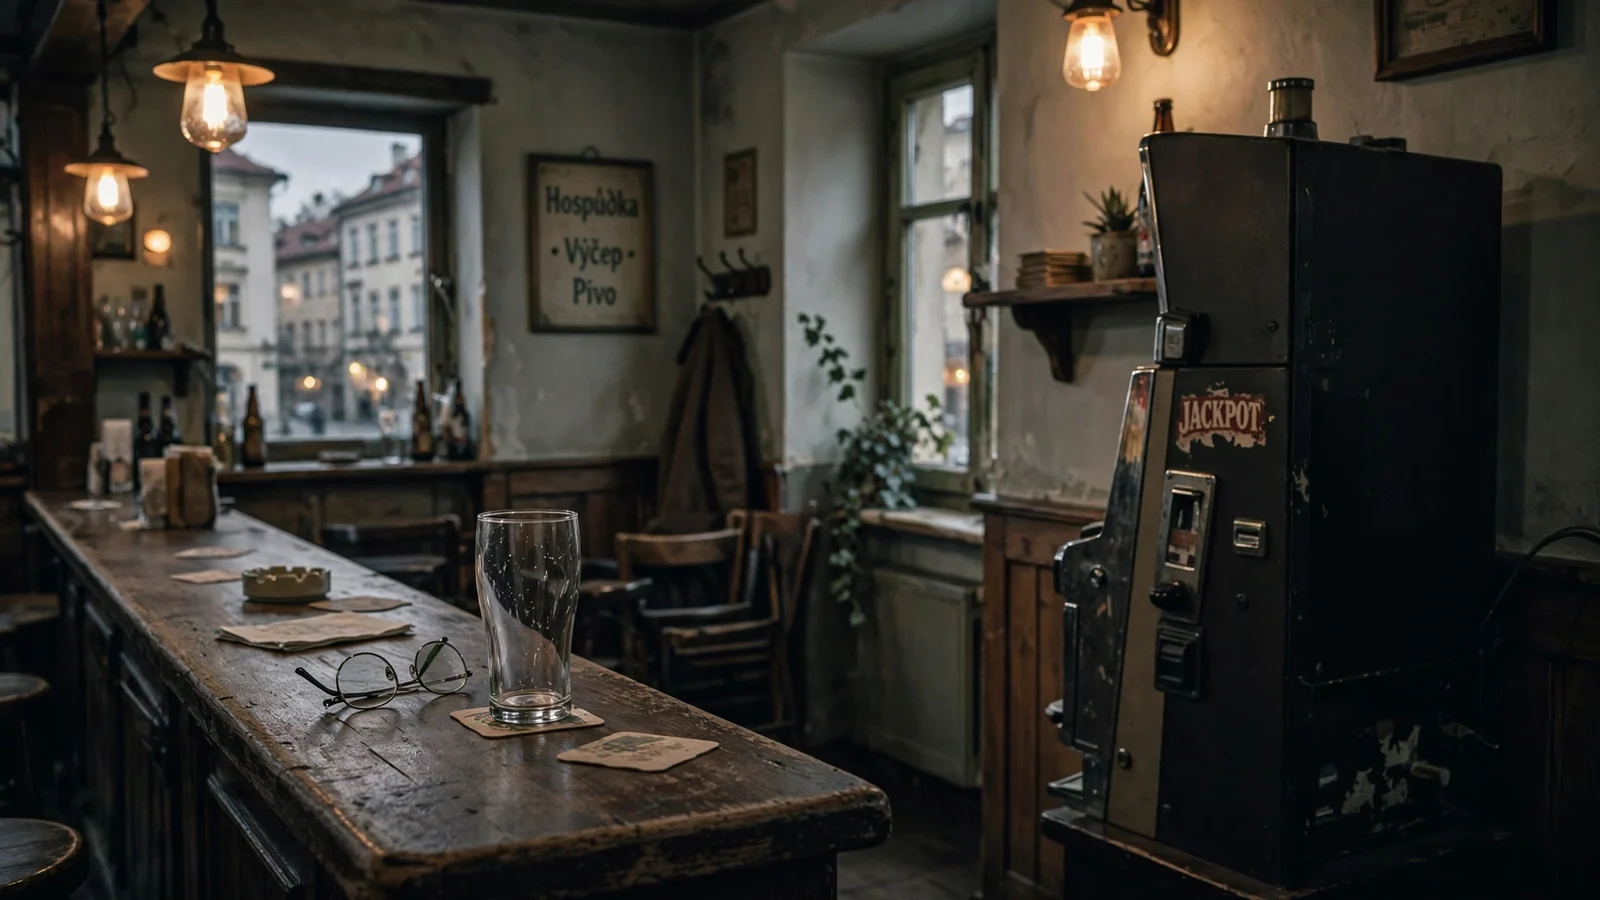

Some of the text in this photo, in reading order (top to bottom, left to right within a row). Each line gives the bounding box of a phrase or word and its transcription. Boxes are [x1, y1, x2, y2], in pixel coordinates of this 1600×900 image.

[564, 237, 623, 272] Výčep
[573, 277, 617, 306] Pivo
[1179, 400, 1261, 434] JACKPOT
